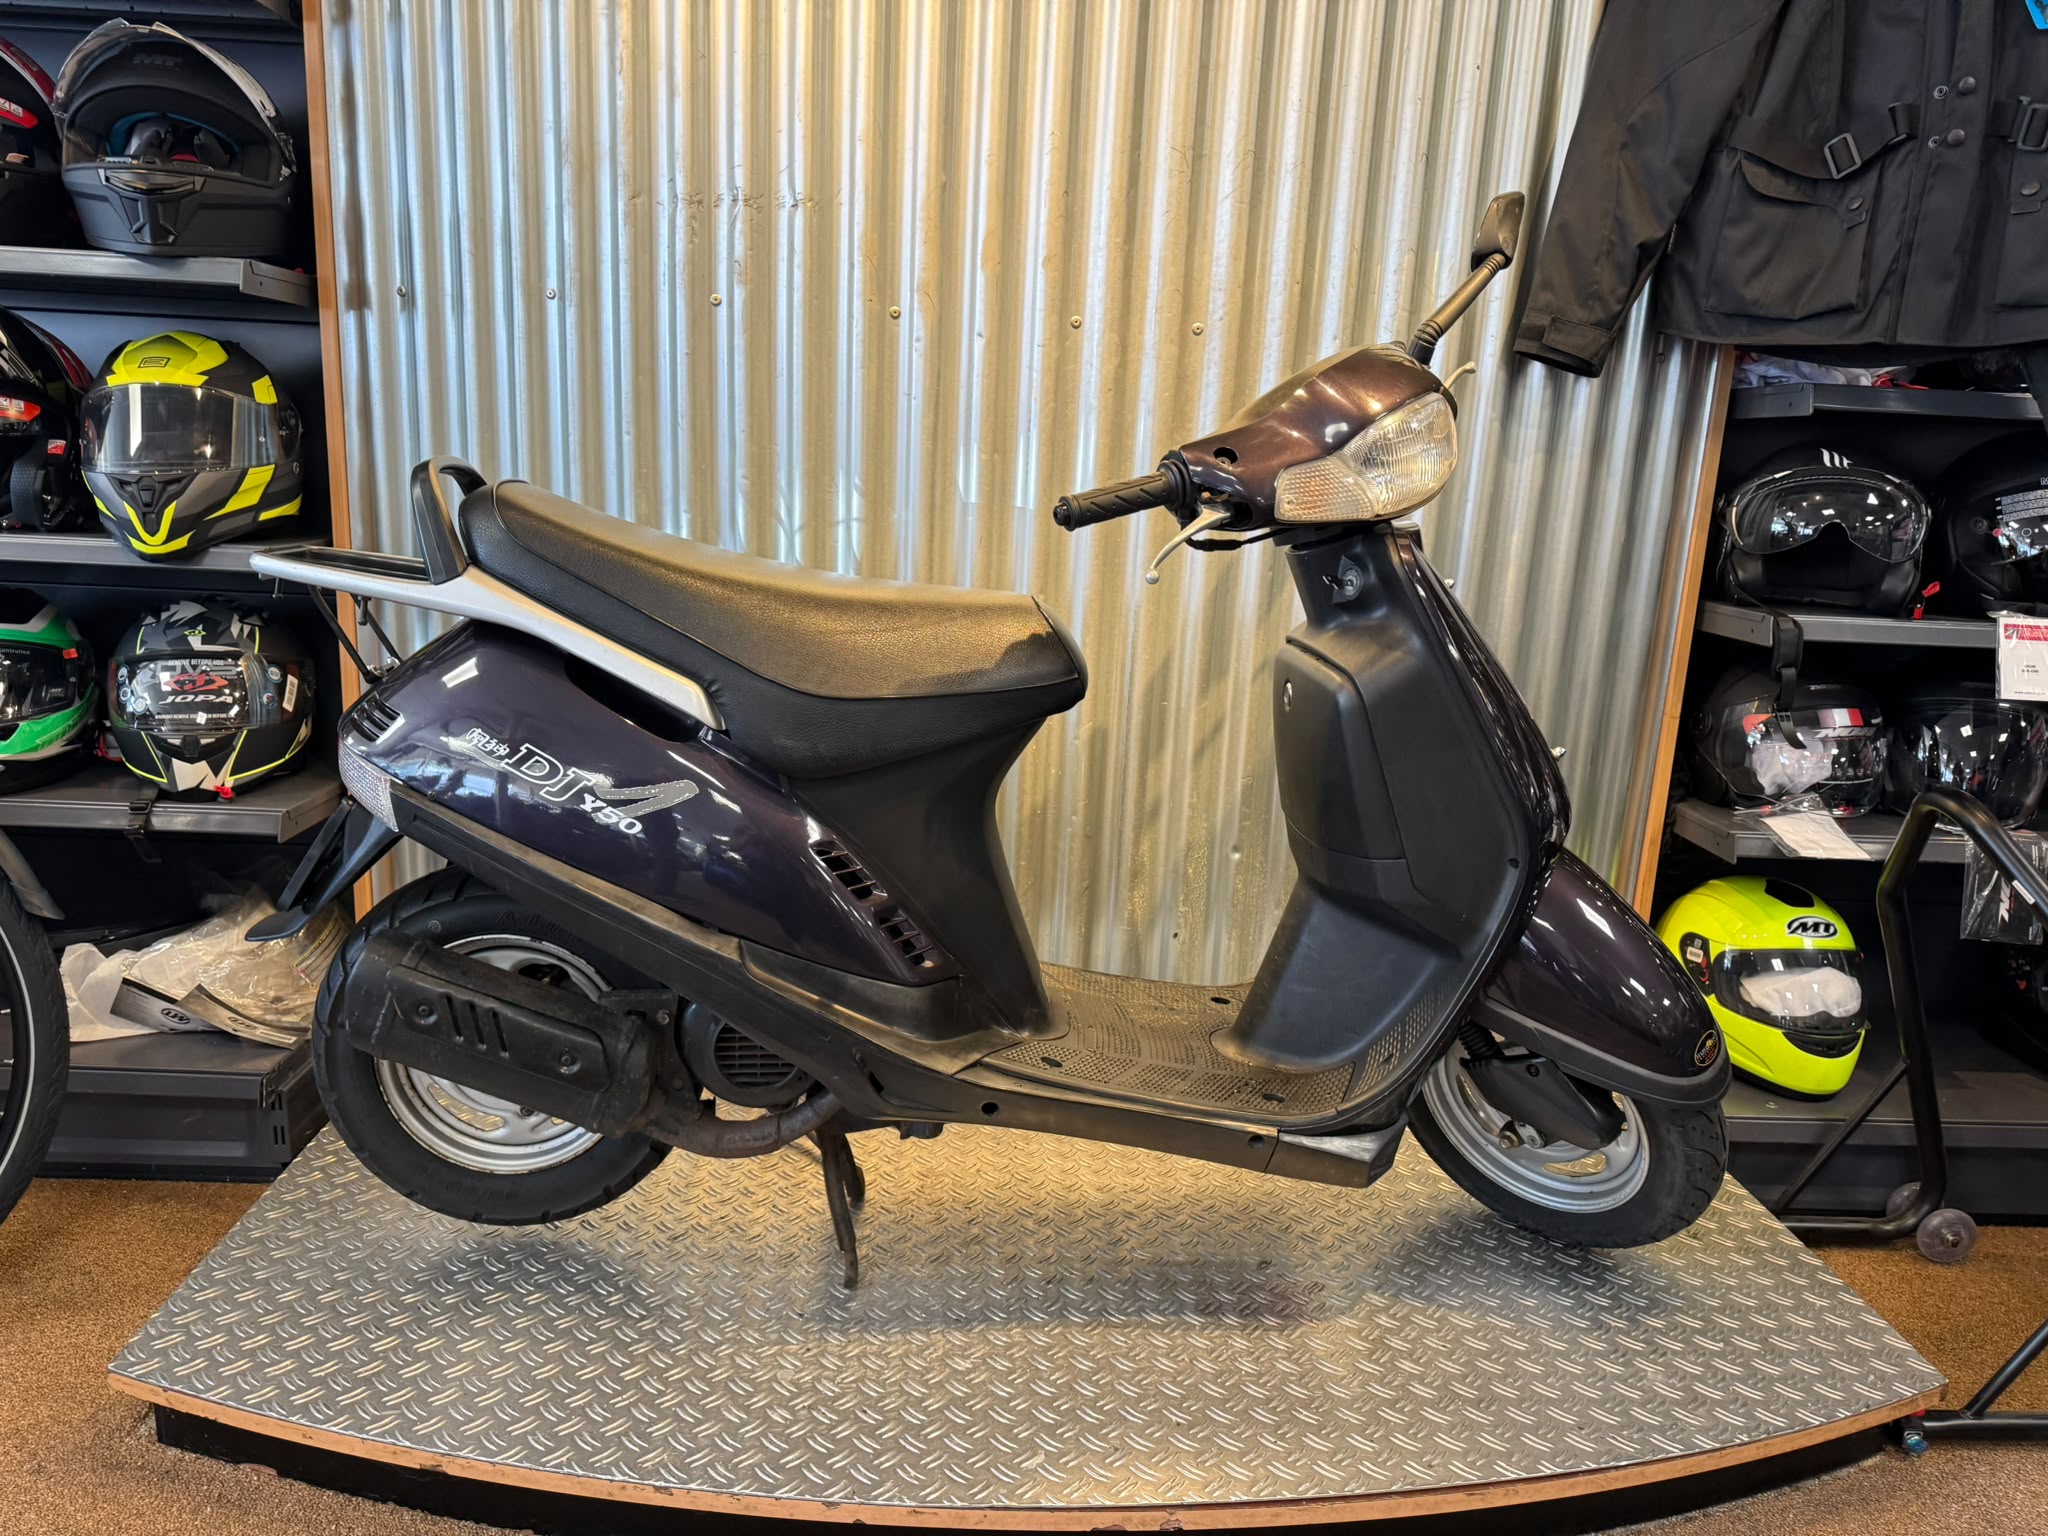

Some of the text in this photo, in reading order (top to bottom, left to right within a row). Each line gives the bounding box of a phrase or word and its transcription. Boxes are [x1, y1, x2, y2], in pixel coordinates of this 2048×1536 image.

[158, 694, 234, 705] JOPA
[500, 743, 598, 801] DJ
[579, 792, 643, 834] Y50
[1787, 917, 1837, 936] MT
